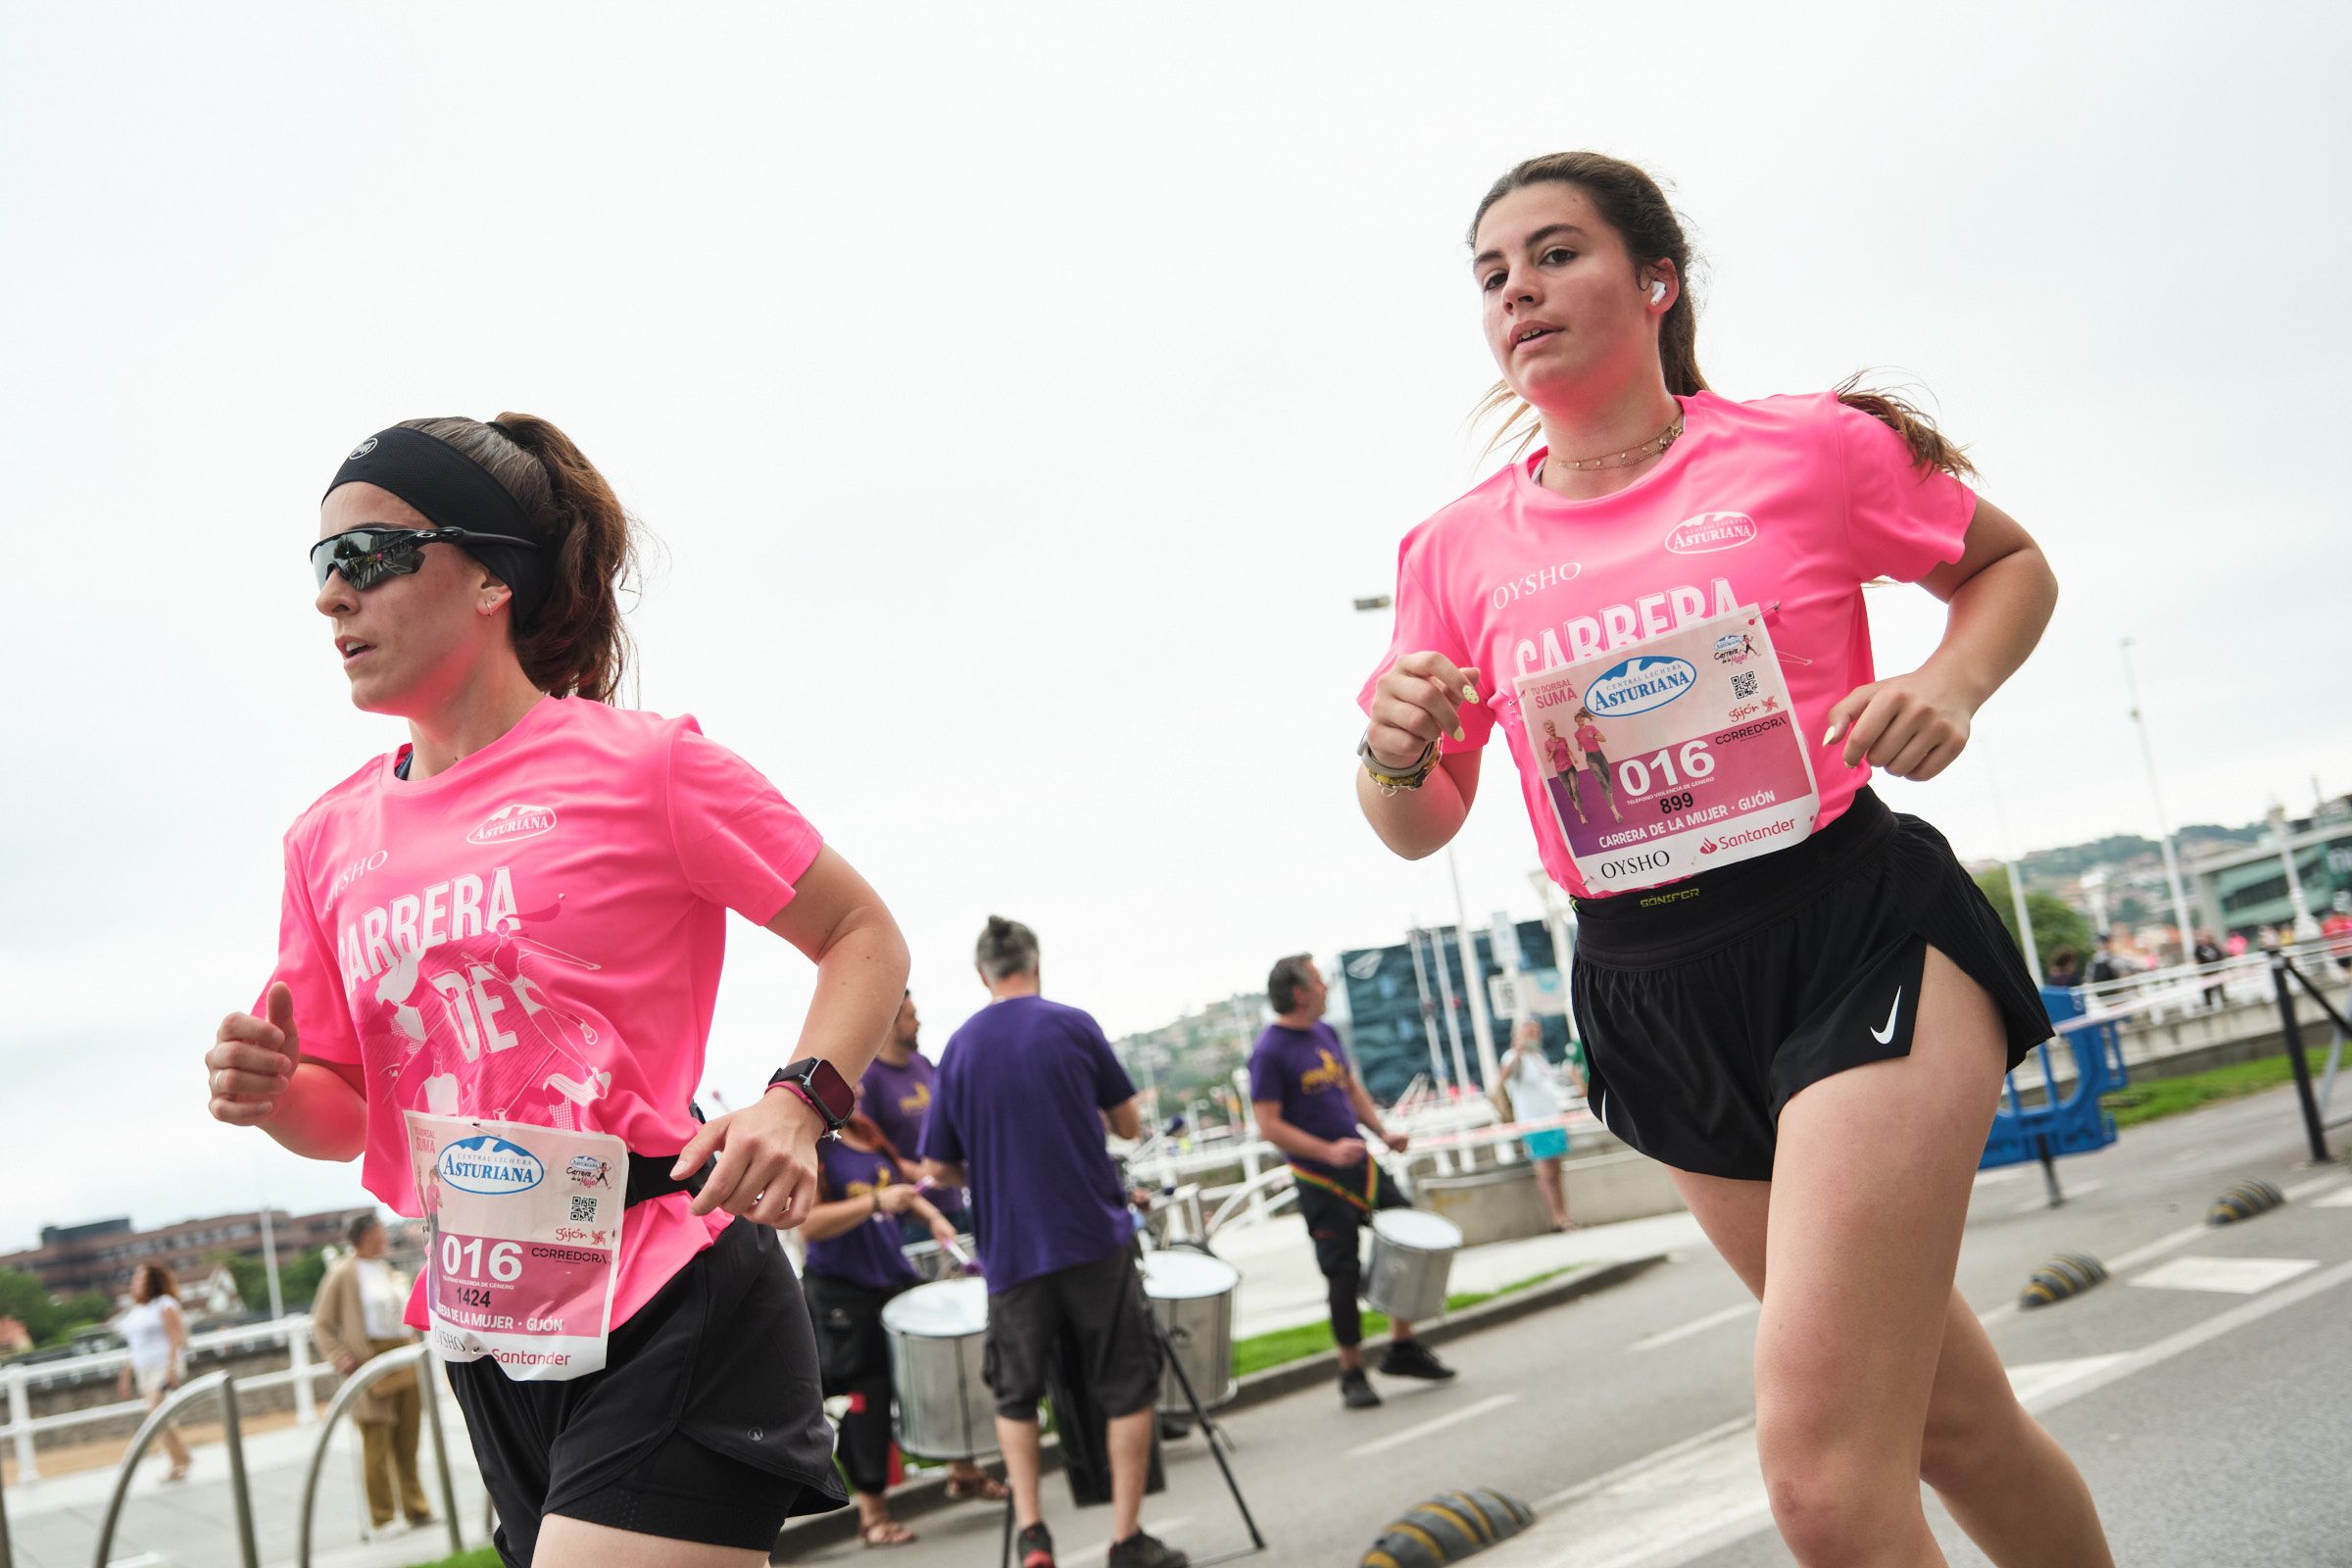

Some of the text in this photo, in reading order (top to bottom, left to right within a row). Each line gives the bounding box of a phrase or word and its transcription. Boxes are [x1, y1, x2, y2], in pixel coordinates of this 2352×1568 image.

[1674, 524, 1751, 550] ASTURIANA
[1493, 562, 1583, 611] OYSHO
[1530, 678, 1573, 697] TU DORSAL
[1606, 663, 1682, 692] CENTRAL LECHERA
[1535, 687, 1578, 710] SUMA
[1594, 671, 1690, 711] ASTURIANA
[1729, 704, 1760, 723] gijón
[1715, 716, 1787, 746] CORREDORA
[1619, 740, 1715, 797] 016
[1659, 792, 1693, 814] 899
[472, 815, 549, 841] ASTURIANA
[1598, 790, 1777, 849] CARRERA DE LA MUJER GIJÓN
[1719, 817, 1795, 851] Santander
[1600, 850, 1670, 879] OYSHO
[427, 960, 519, 1064] DE
[443, 1153, 534, 1184] ASTURIANA
[457, 1152, 532, 1166] CENTRAL LECHERA
[556, 1228, 587, 1242] gijón
[442, 1235, 523, 1283] 016
[531, 1248, 607, 1264] CORREDORA
[457, 1287, 491, 1308] 1424
[460, 1310, 470, 1325] LA
[470, 1312, 514, 1330] MUJER
[526, 1315, 564, 1333] GIJÓN
[492, 1348, 571, 1366] Santander
